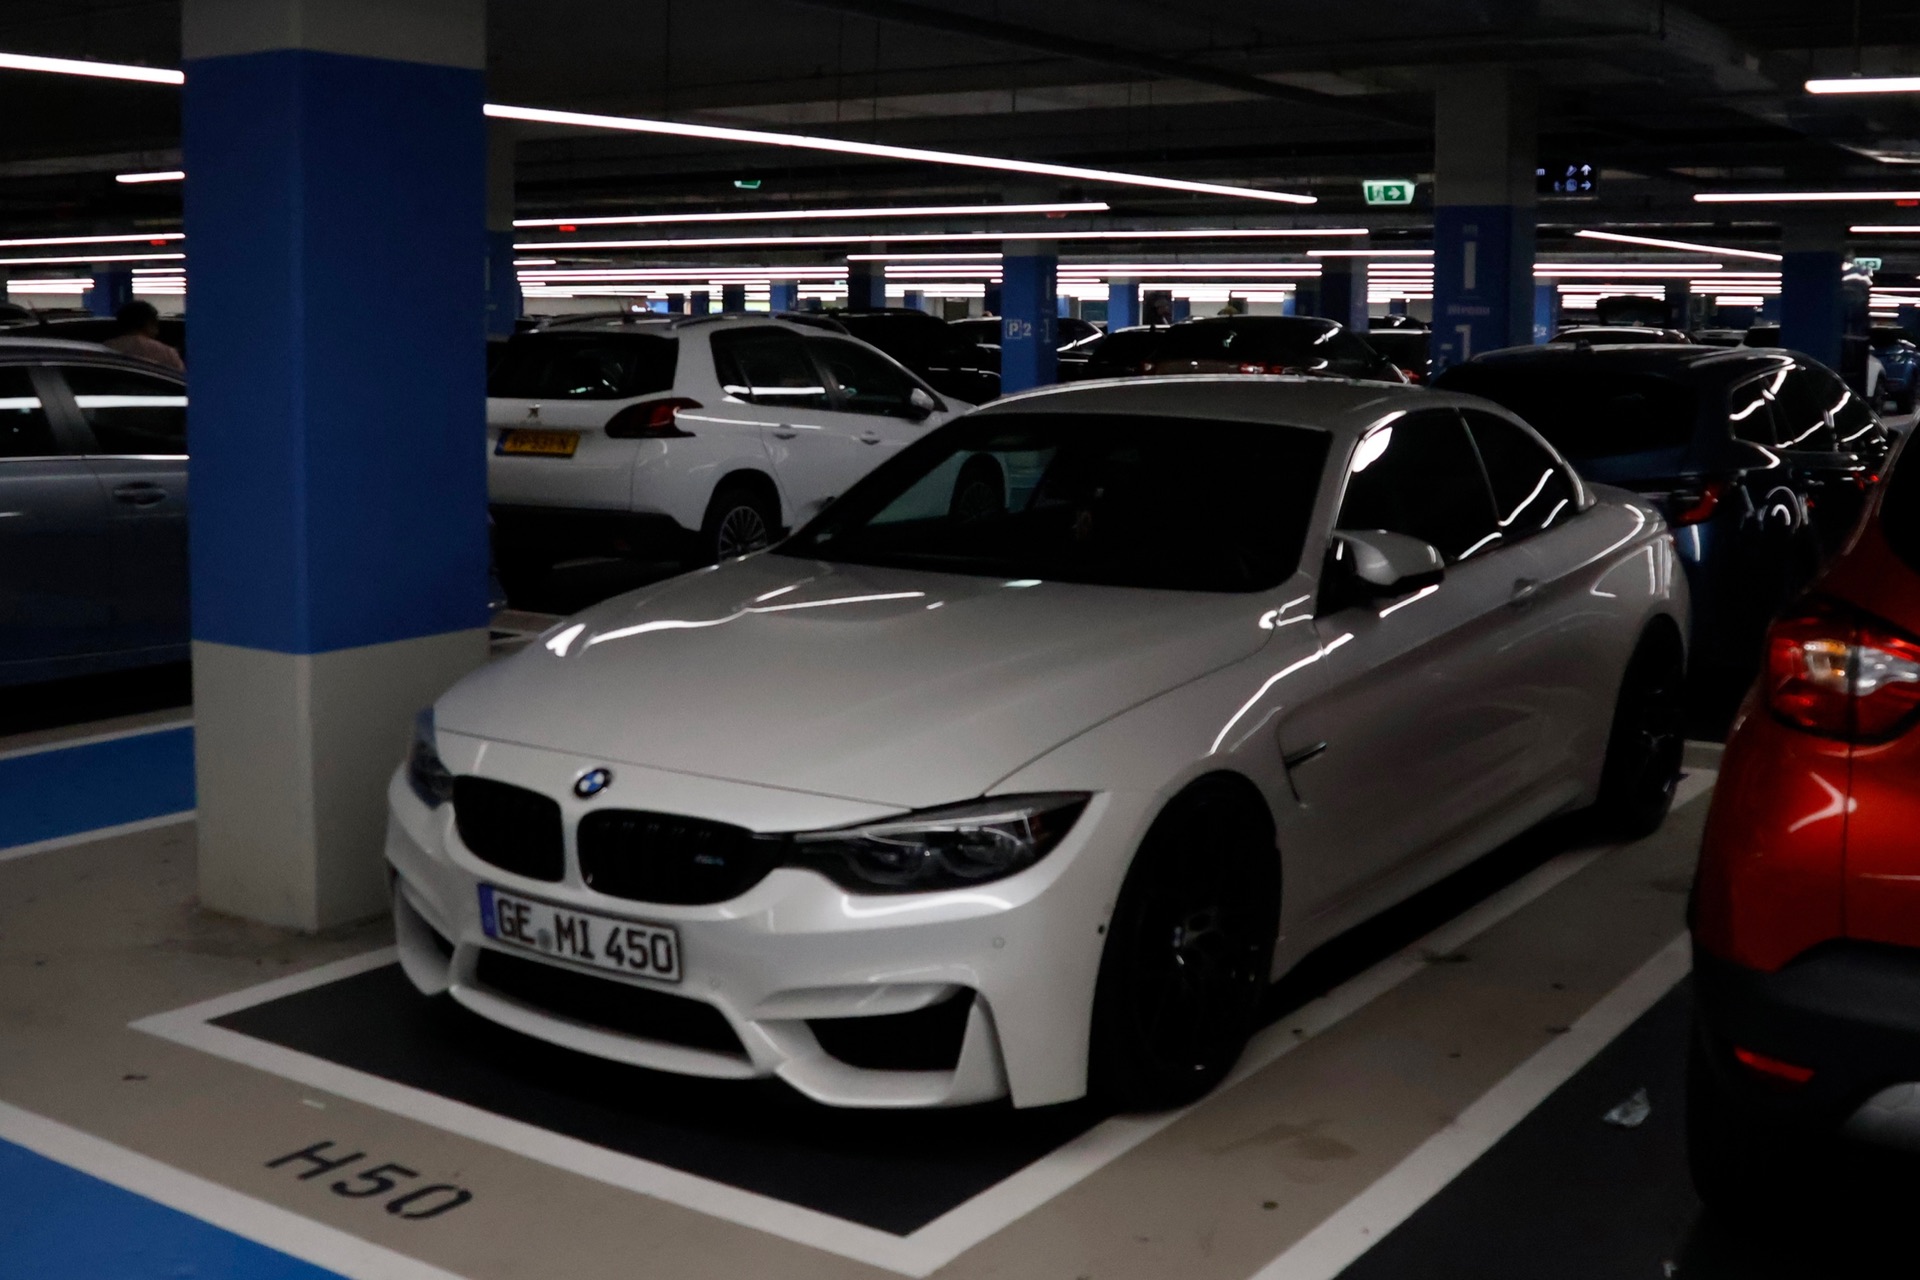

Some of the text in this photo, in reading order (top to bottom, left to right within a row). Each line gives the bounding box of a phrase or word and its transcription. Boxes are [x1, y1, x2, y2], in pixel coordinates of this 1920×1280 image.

[498, 899, 673, 973] GE MI 450
[264, 1140, 473, 1220] H50
